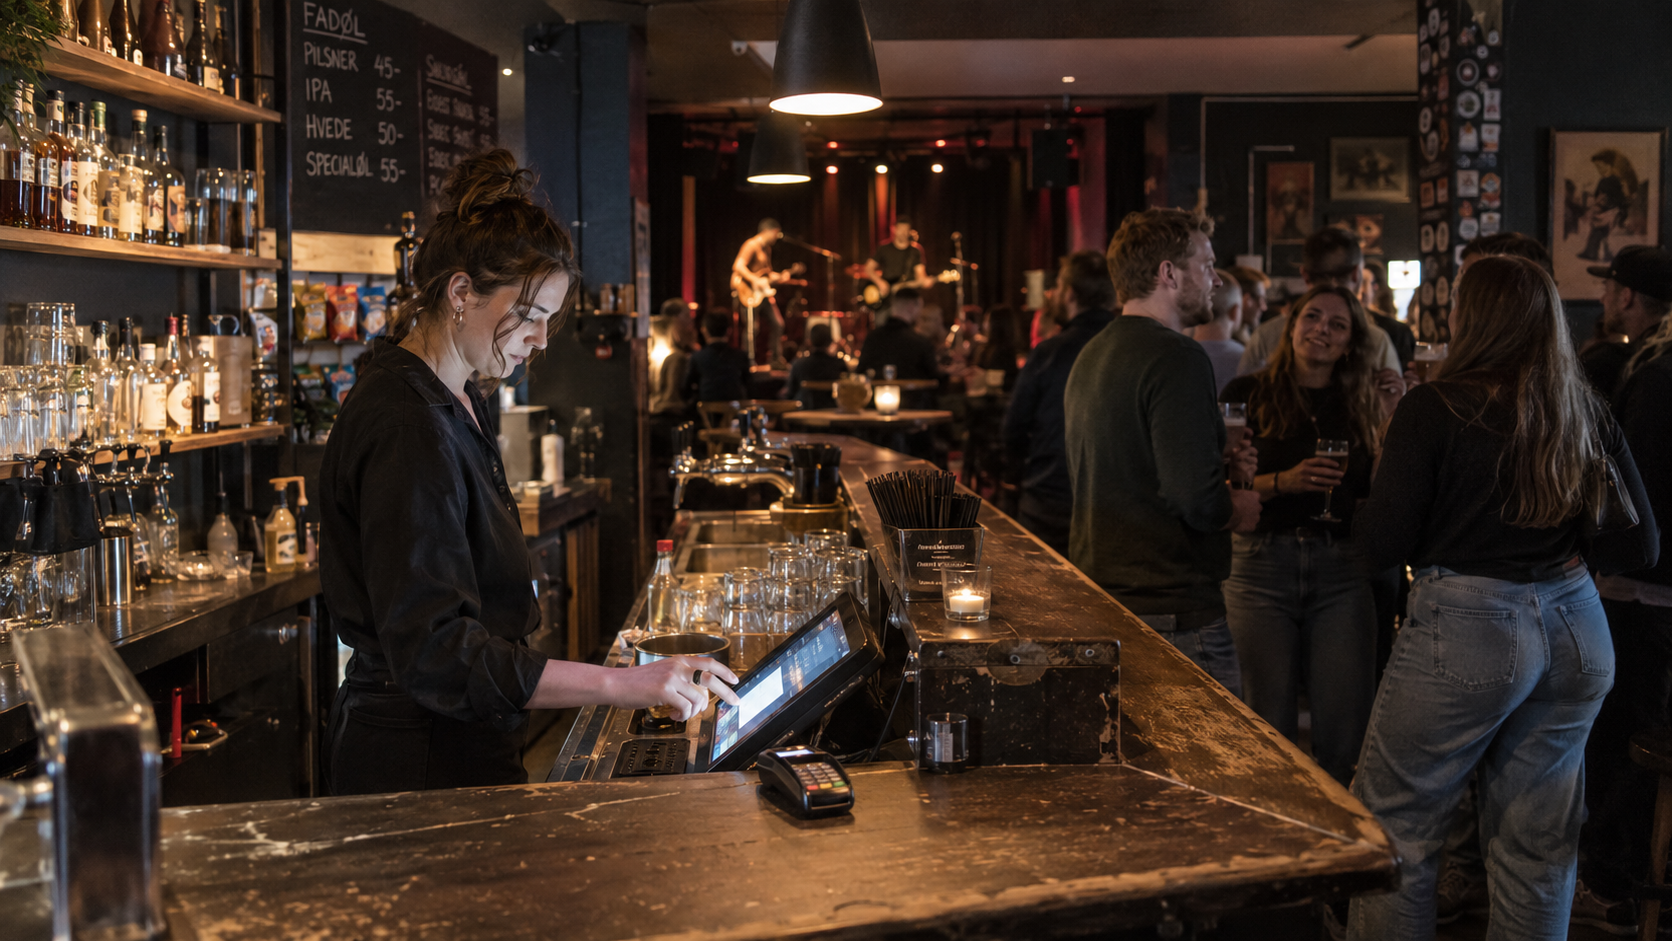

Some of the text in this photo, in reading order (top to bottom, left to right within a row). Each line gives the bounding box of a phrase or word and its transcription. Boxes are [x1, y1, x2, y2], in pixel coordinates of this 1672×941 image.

[303, 2, 366, 38] FADØL
[374, 54, 401, 79] 45-
[306, 78, 332, 103] IPA
[376, 87, 402, 111] 55-
[306, 114, 353, 140] HVEDE
[378, 121, 404, 145] 50-
[306, 151, 373, 178] SPECIALØL
[381, 157, 406, 183] 55-
